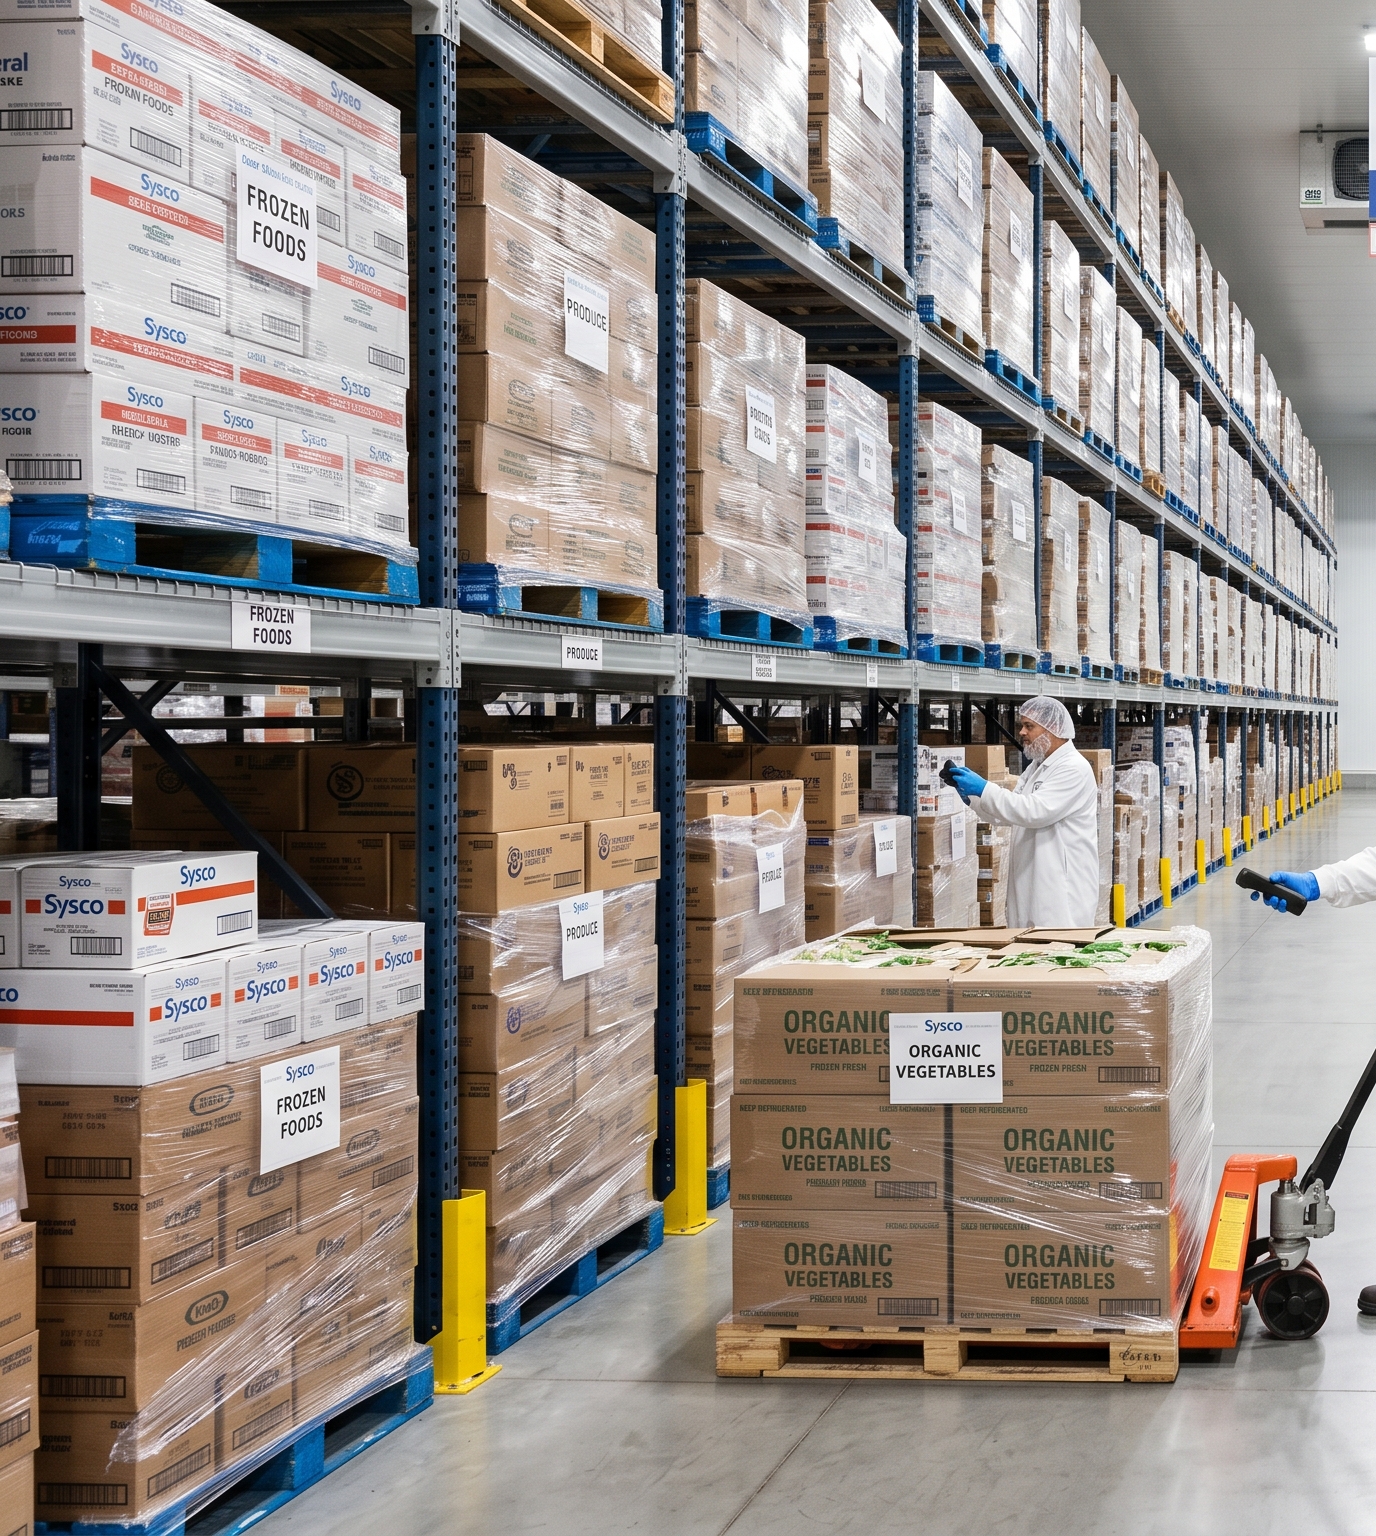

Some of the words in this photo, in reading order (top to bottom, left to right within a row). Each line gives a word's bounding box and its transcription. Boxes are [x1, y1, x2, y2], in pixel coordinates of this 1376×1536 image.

[0, 52, 28, 71] ral
[140, 173, 180, 202] Sysco
[247, 183, 310, 231] FROZEN
[253, 220, 307, 262] FOODS
[144, 317, 188, 344] Sysco
[127, 386, 164, 408] Sysco
[0, 407, 37, 421] sco
[250, 605, 294, 624] FROZEN
[253, 627, 292, 646] FOODS
[59, 875, 91, 890] Sysco
[180, 865, 216, 888] Sysco
[44, 893, 104, 919] Sysco
[566, 920, 599, 942] PRODUCE
[384, 950, 413, 972] Sysco
[320, 963, 354, 986] Sysco
[247, 978, 286, 1004] Sysco
[164, 995, 208, 1022] Sysco
[784, 1010, 892, 1033] ORGANIC
[924, 1019, 963, 1034] Sysco
[1003, 1011, 1115, 1035] ORGANIC
[784, 1038, 890, 1055] VEGETABLES
[908, 1044, 981, 1058] ORGANIC
[1003, 1039, 1114, 1056] VEGETABLES
[285, 1063, 315, 1083] Sysco
[896, 1064, 996, 1079] VEGETABLES
[276, 1085, 326, 1116] FROZEN
[280, 1114, 323, 1140] FOODS
[781, 1127, 892, 1151] ORGANIC
[1004, 1128, 1115, 1152] ORGANIC
[782, 1154, 892, 1172] VEGETABLES
[1004, 1156, 1115, 1174] VEGETABLES
[784, 1242, 893, 1267] ORGANIC
[1004, 1244, 1115, 1268] ORGANIC
[784, 1270, 893, 1288] VEGETABLES
[1005, 1272, 1115, 1290] VEGETABLES
